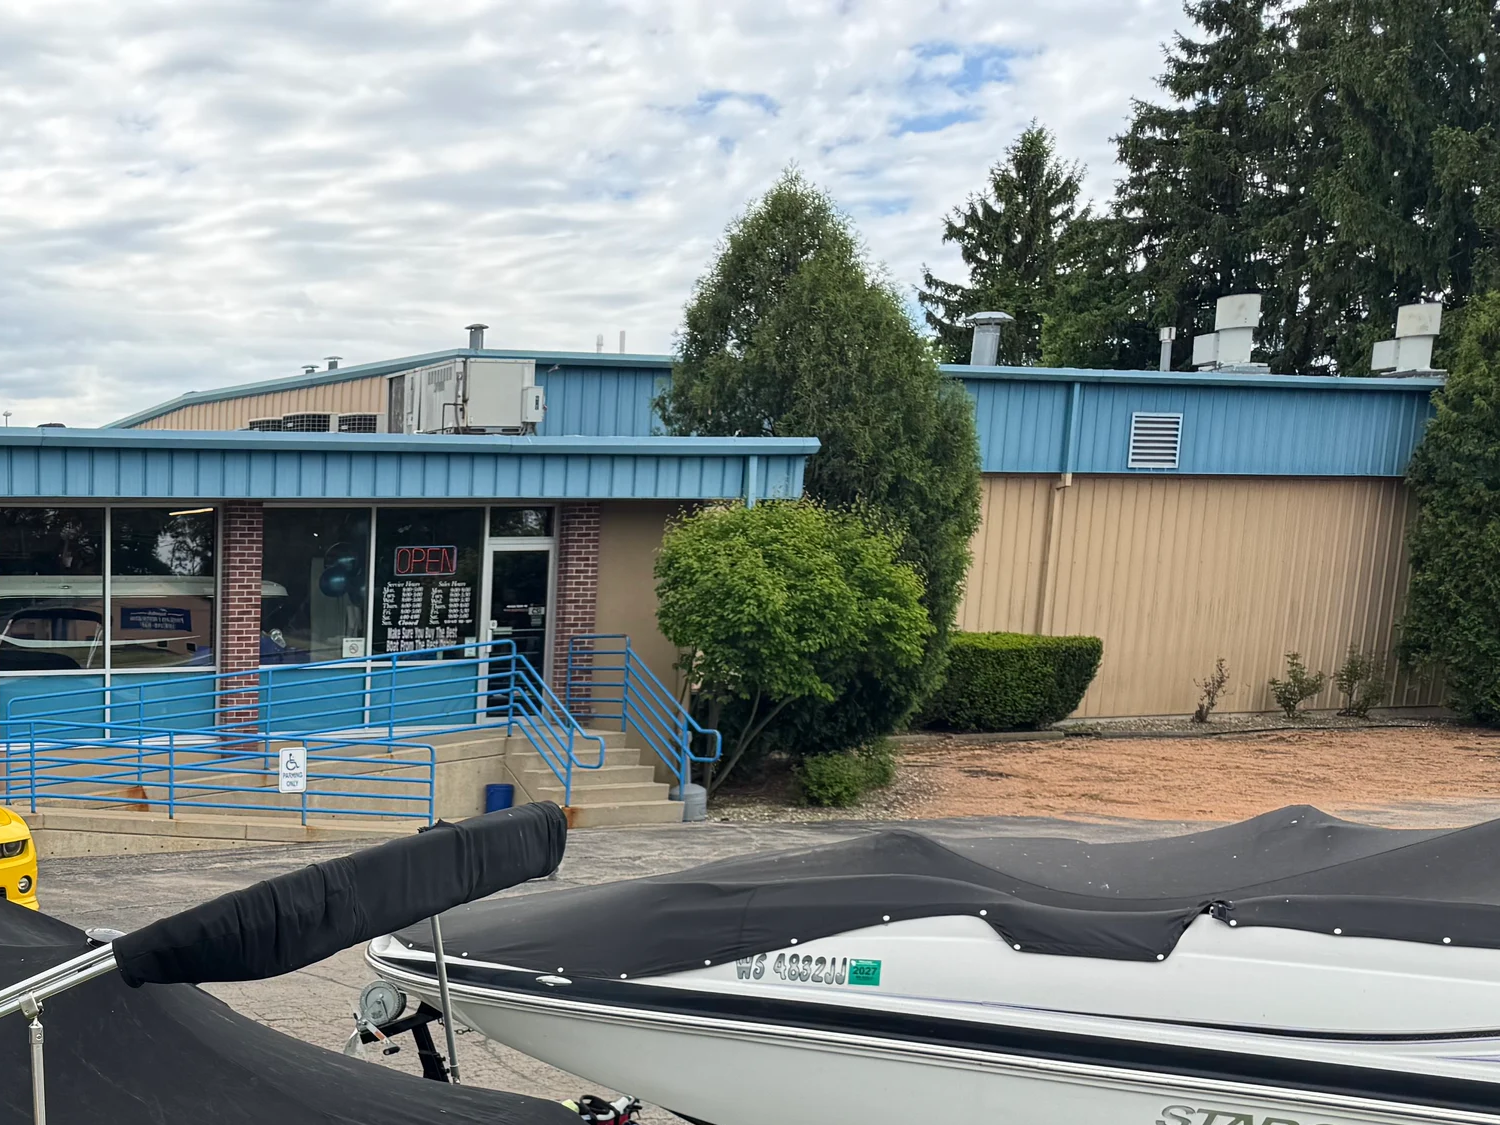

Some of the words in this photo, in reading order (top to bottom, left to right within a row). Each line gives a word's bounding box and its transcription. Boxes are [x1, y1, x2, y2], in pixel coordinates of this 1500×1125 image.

[397, 547, 456, 574] OPEN
[387, 627, 401, 639] Make
[401, 627, 414, 639] Sure
[414, 627, 425, 639] You
[425, 626, 435, 640] Buy
[436, 626, 445, 638] The
[446, 626, 458, 638] Best
[386, 640, 399, 652] Boat
[400, 640, 414, 652] From
[415, 640, 425, 651] The
[735, 953, 768, 980] WS
[853, 966, 878, 976] 2027
